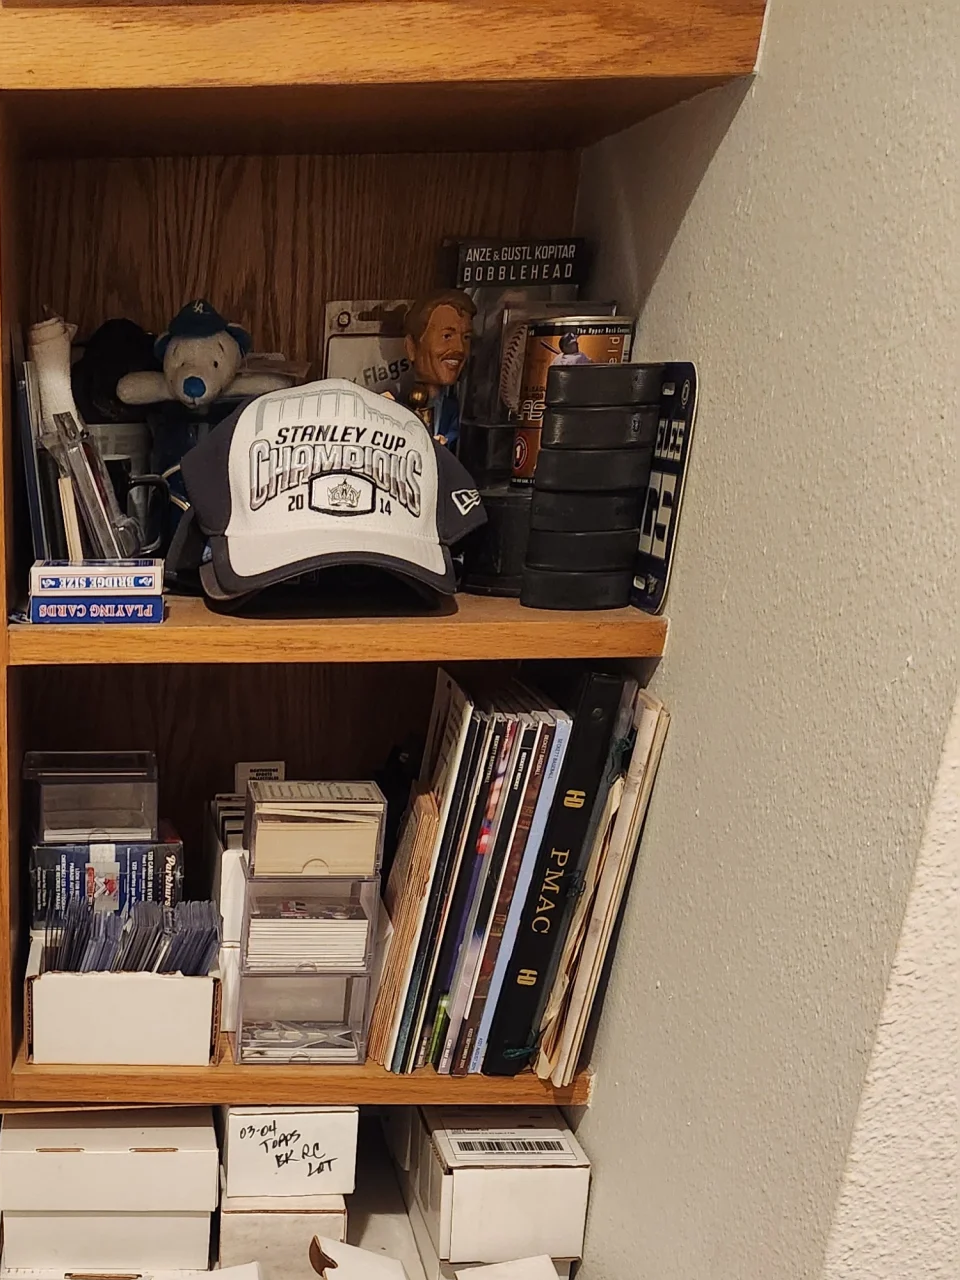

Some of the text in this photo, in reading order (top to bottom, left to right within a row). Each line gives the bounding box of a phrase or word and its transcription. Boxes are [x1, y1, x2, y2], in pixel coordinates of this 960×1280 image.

[465, 244, 576, 263] ANZE & GUSTL KOPITAR
[463, 263, 573, 282] BOBBLEHEAD
[362, 357, 411, 386] Flags
[275, 424, 406, 452] STANLEY CUP
[249, 438, 423, 518] CHAMPIONS
[287, 494, 392, 516] 20 14
[58, 576, 135, 589] BRIDGE SIZE
[38, 604, 153, 618] PLAYING CARDS
[164, 854, 177, 907] Parkhurs
[531, 848, 570, 934] PMAC
[239, 1119, 278, 1140] 03-04
[301, 1142, 327, 1160] RC
[307, 1157, 339, 1178] LOT
